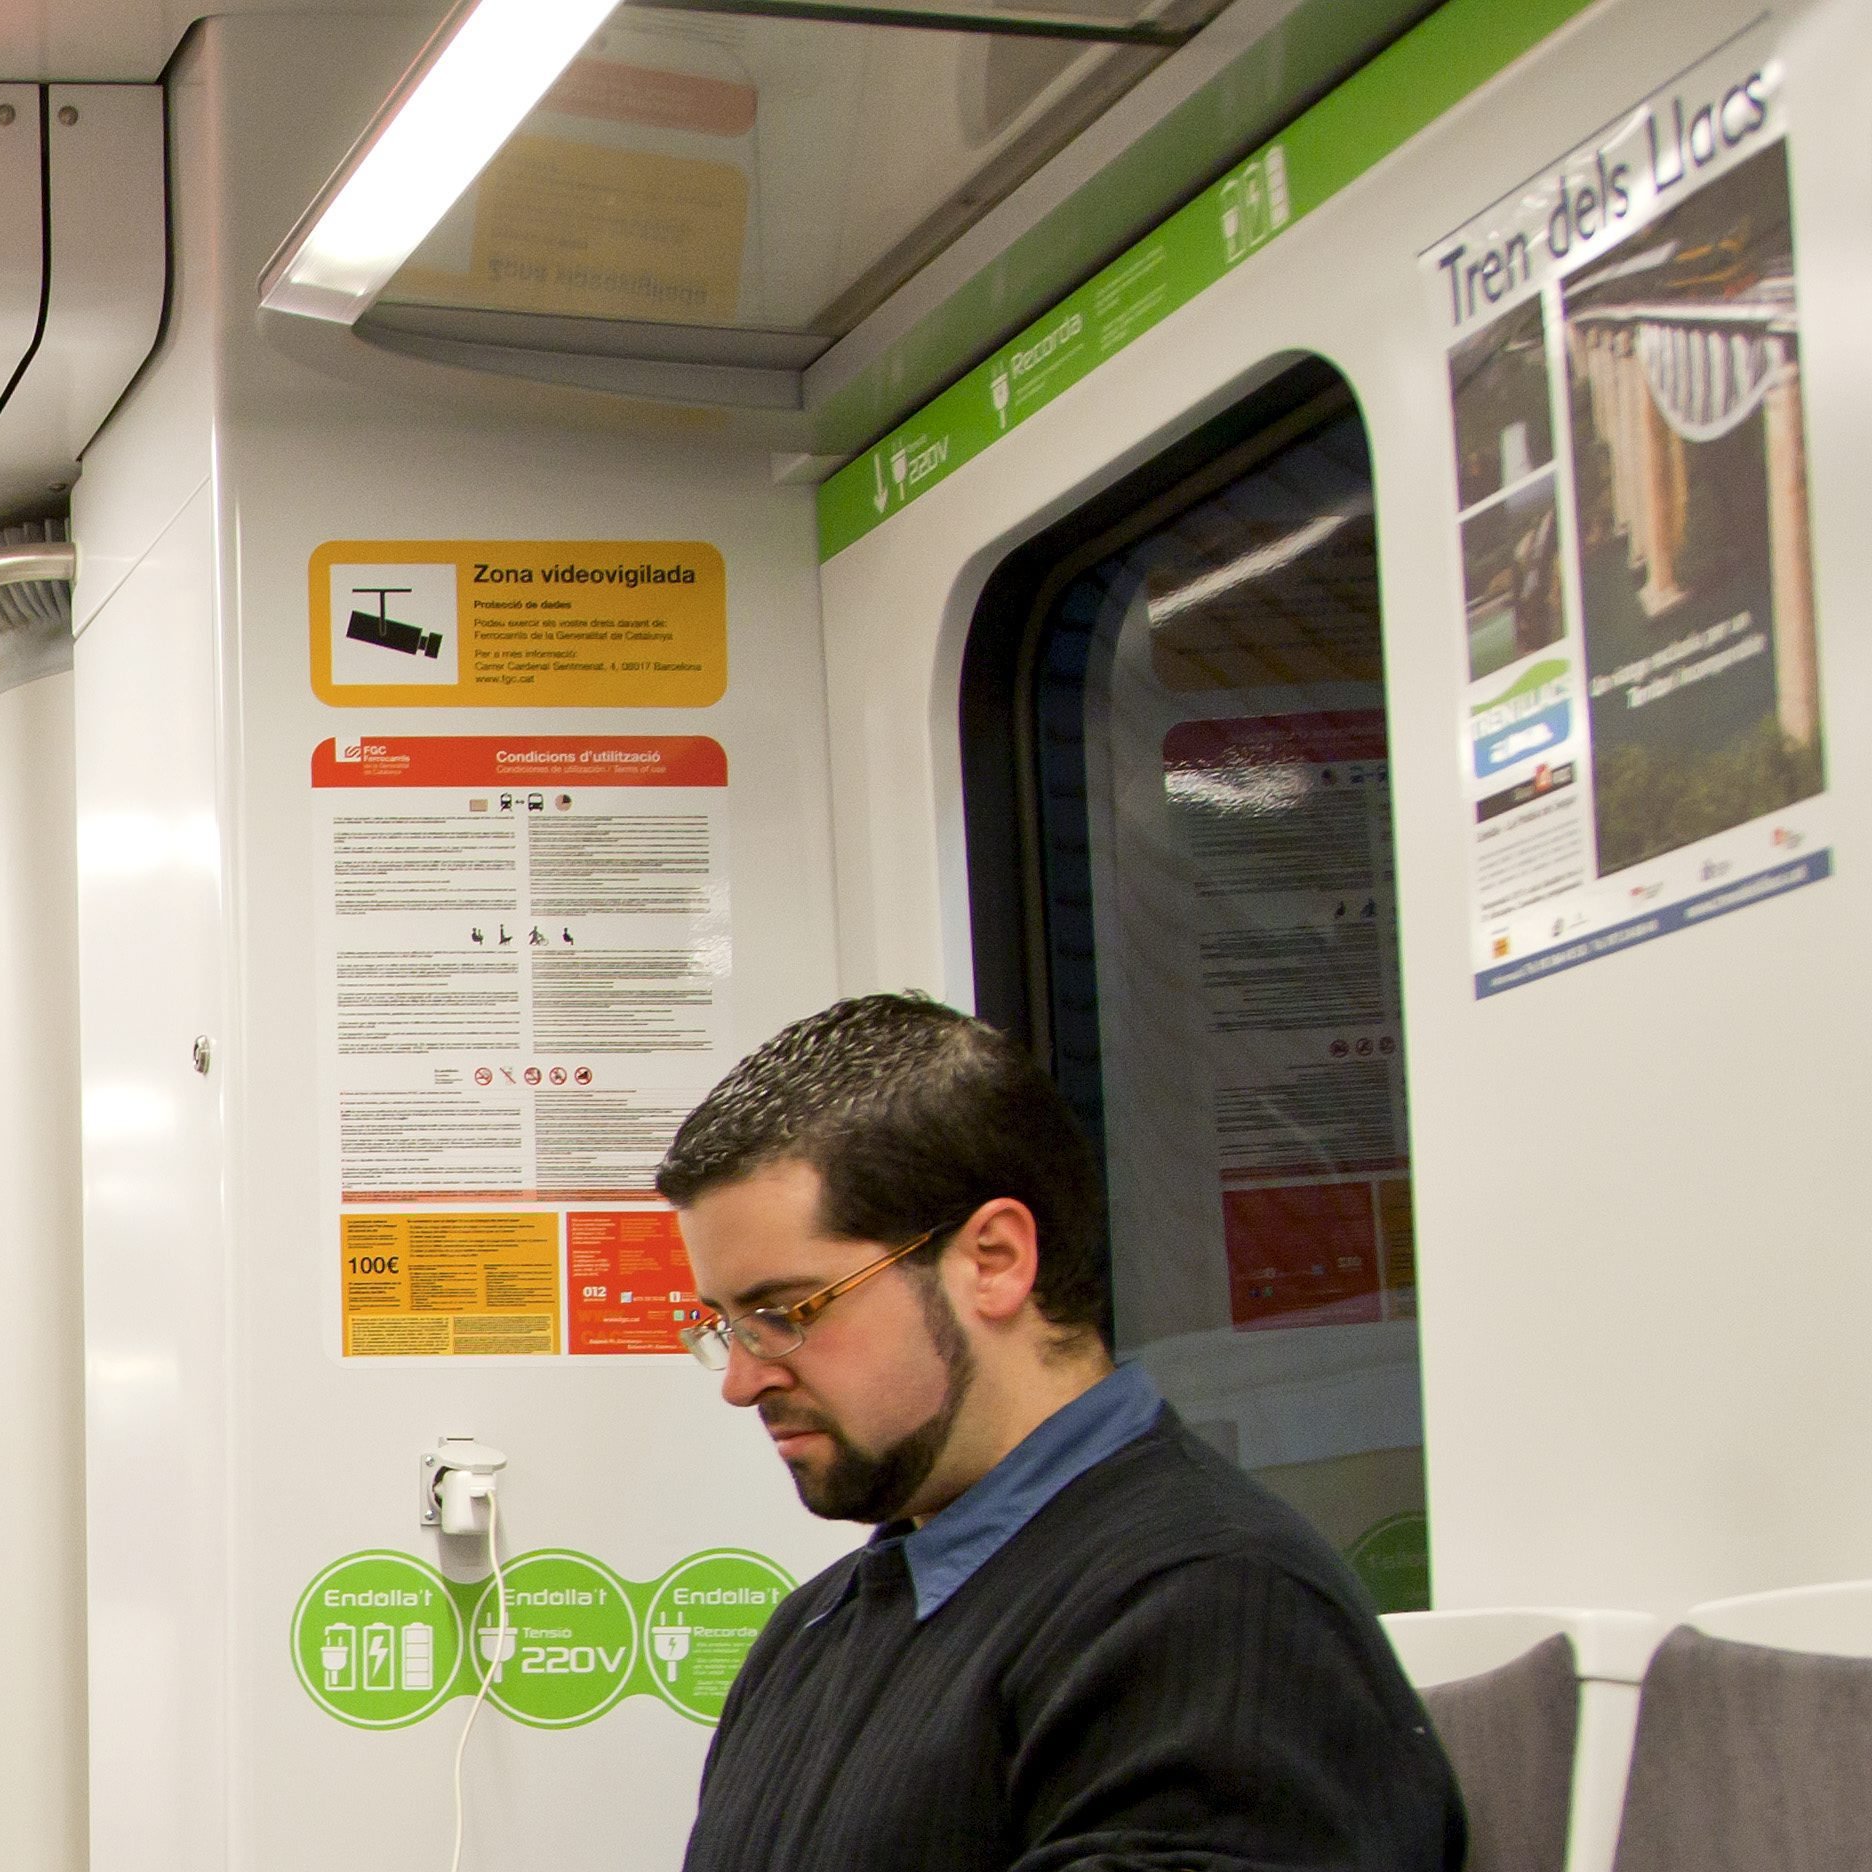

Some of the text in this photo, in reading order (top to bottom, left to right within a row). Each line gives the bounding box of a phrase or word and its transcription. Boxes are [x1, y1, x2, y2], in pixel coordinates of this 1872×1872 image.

[1438, 72, 1770, 327] Tren dels Llacs
[1011, 312, 1084, 378] Recorda
[473, 563, 696, 588] Zona videovigilada
[540, 600, 572, 610] dades
[362, 745, 387, 755] FGC
[495, 750, 661, 763] Condicions d'utilització
[347, 1256, 400, 1274] 100€
[582, 1286, 607, 1298] 012
[324, 1588, 433, 1607] Endolla't
[504, 1587, 608, 1606] Endolla't
[672, 1586, 781, 1605] Endolla't
[522, 1625, 573, 1640] Tensió
[521, 1646, 627, 1674] 220V
